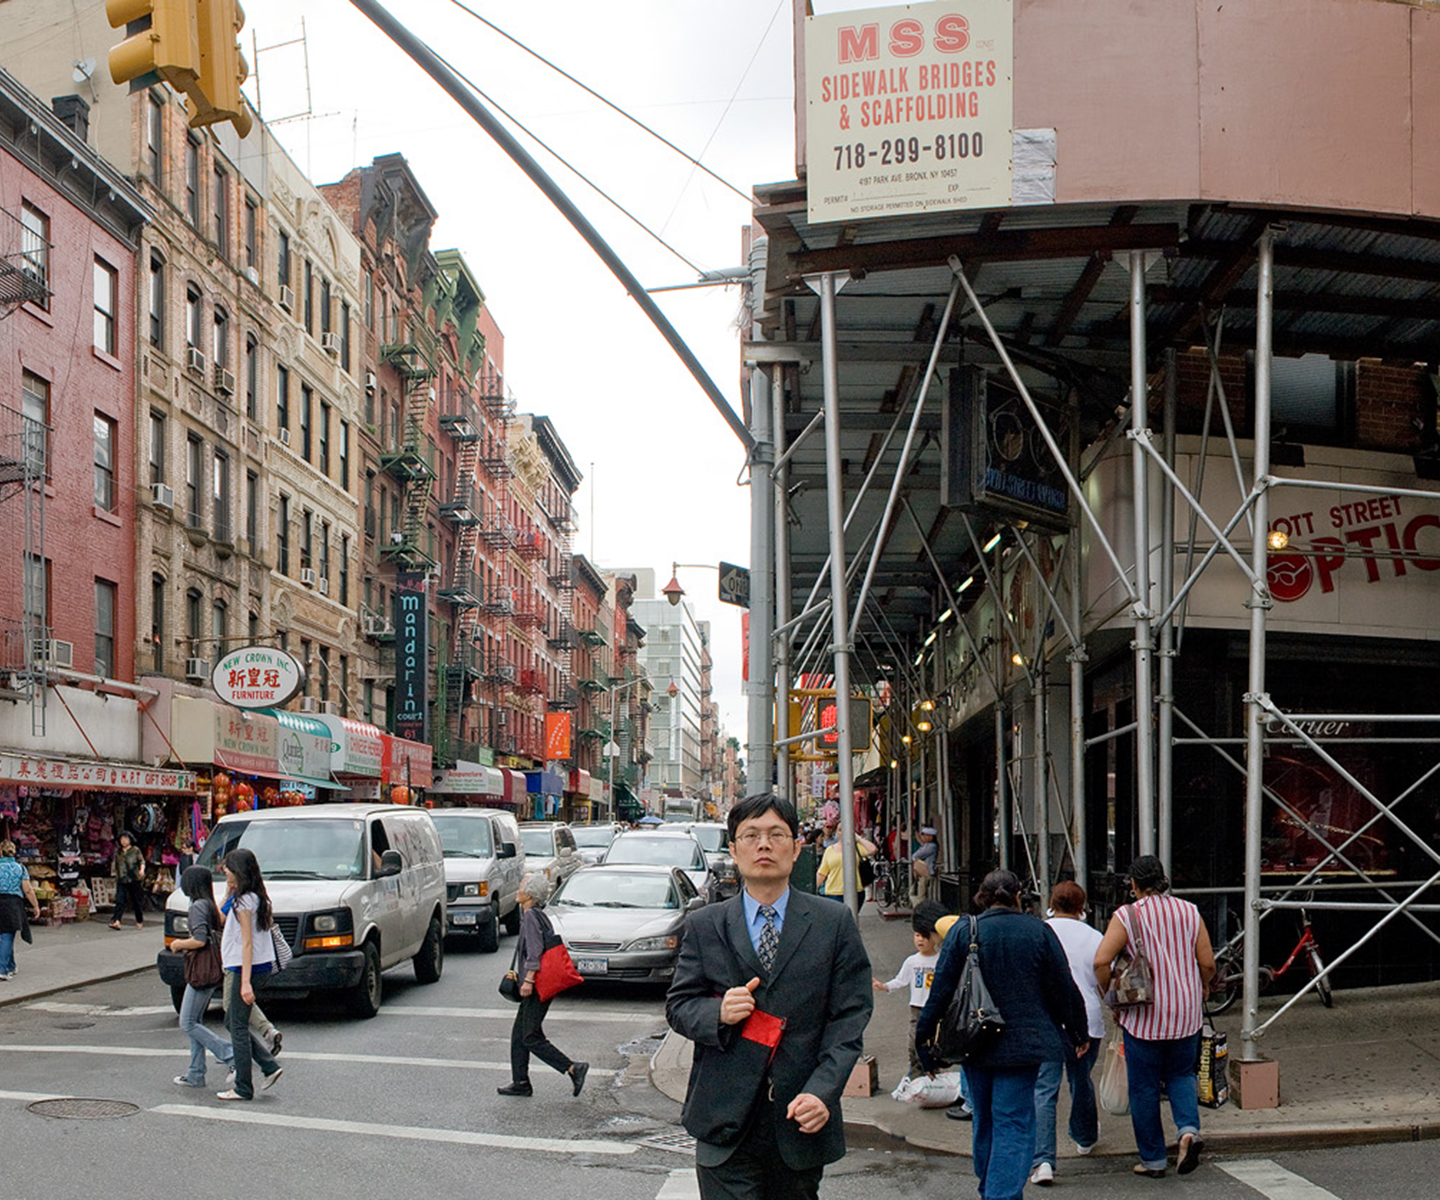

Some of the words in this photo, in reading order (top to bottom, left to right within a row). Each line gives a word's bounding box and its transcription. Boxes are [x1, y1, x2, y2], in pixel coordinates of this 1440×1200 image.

[837, 13, 971, 65] MSS
[822, 66, 909, 102] SIDEWALK
[919, 60, 996, 91] BRIDGES
[839, 104, 850, 130] &
[861, 91, 978, 128] SCAFFOLDING
[834, 131, 983, 171] 718-299-8100
[873, 176, 888, 184] PARK
[931, 171, 939, 180] NY
[859, 204, 884, 212] STORAGE
[886, 201, 913, 210] PERMITTED
[915, 200, 923, 208] ON
[924, 197, 952, 207] SIDEWALK
[952, 196, 968, 205] SHED
[1268, 512, 1314, 538] OTT
[1330, 495, 1402, 528] STREET
[223, 656, 241, 671] NEW
[245, 653, 273, 665] CROWN
[399, 595, 419, 711] mandarin
[228, 667, 280, 688] 新皇冠
[232, 690, 275, 700] FURNITURE
[404, 729, 416, 738] 61
[145, 773, 159, 785] GIFT
[161, 775, 177, 787] SHOP
